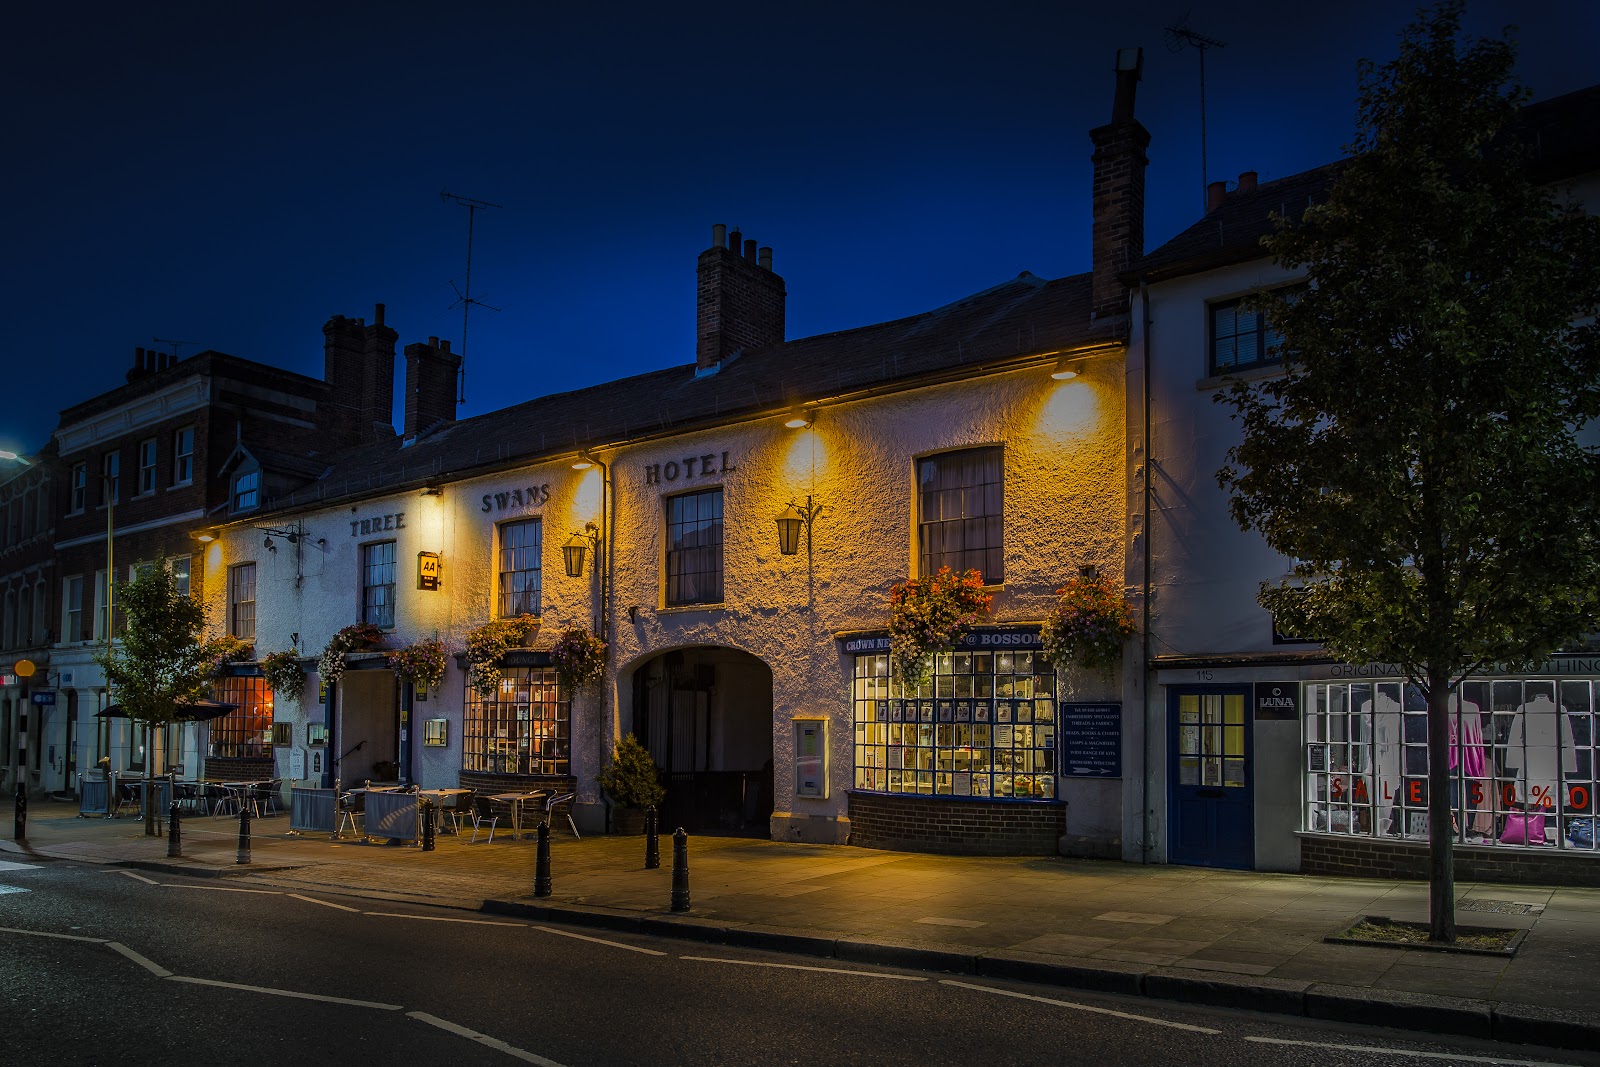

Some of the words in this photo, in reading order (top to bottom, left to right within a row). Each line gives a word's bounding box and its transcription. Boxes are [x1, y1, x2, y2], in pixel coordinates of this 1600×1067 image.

[645, 451, 736, 484] HOTEL
[481, 484, 550, 513] SWANS
[350, 513, 405, 537] THREE
[423, 561, 435, 571] AA
[846, 639, 875, 650] CROWN
[966, 634, 977, 645] @
[510, 656, 538, 664] OUNGE
[1196, 670, 1214, 681] 115
[1330, 664, 1405, 677] ORIGINA
[1259, 698, 1294, 707] LUNA
[1333, 778, 1422, 802] SALE
[1471, 783, 1553, 808] 50%
